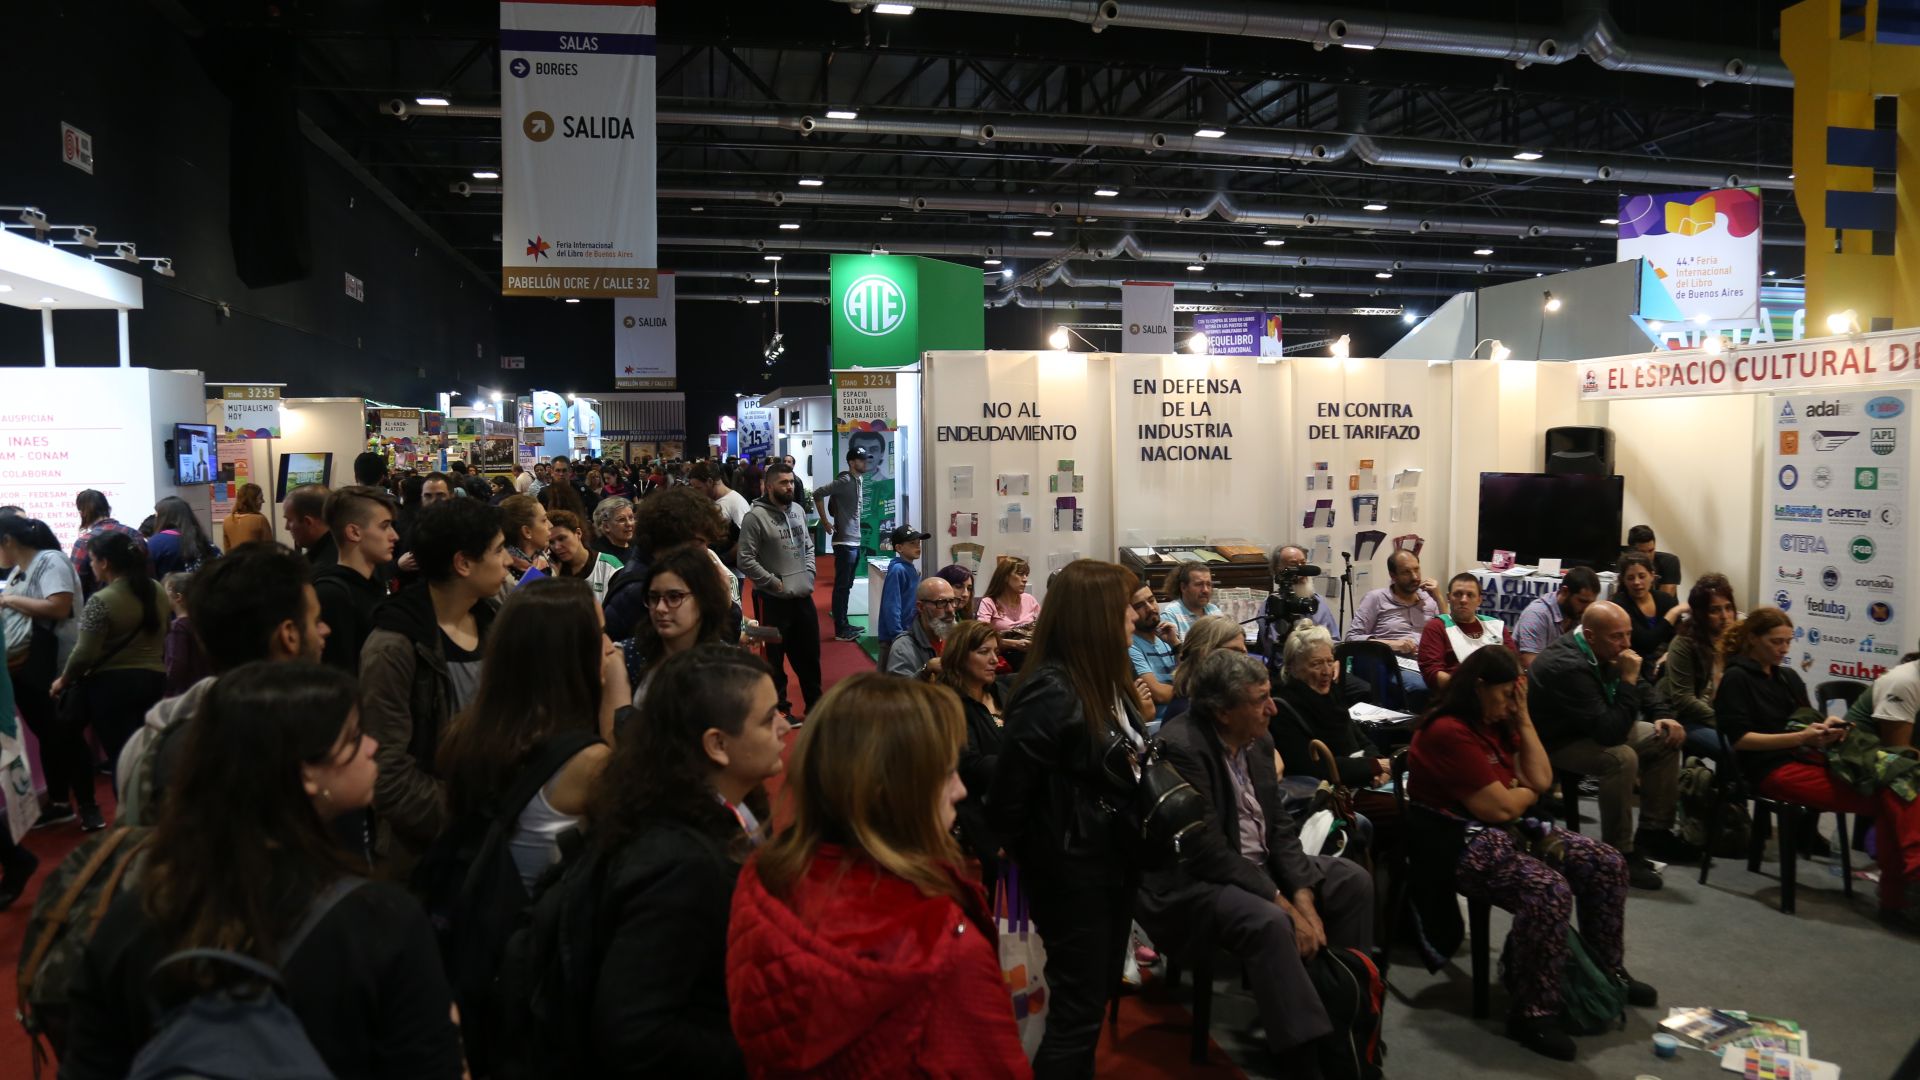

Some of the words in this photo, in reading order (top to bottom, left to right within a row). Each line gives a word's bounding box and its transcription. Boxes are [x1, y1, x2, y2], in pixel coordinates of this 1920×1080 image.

[560, 36, 599, 50] SALAS
[536, 62, 578, 76] BORGES
[563, 116, 634, 139] SALIDA
[573, 241, 614, 249] Internacional
[584, 250, 592, 258] de
[594, 250, 616, 258] Buenos
[618, 250, 634, 258] Aires
[1696, 256, 1718, 265] Feria
[1676, 265, 1732, 277] Internacional
[508, 274, 560, 288] PABELLÓN
[564, 277, 590, 289] OCRE
[593, 277, 600, 290] /
[603, 277, 634, 290] CALLE
[636, 278, 650, 290] 32
[1676, 280, 1688, 288] del
[1691, 279, 1712, 288] Libro
[1676, 290, 1686, 299] de
[1688, 290, 1718, 298] Buenos
[1722, 288, 1744, 296] Aires
[848, 279, 899, 331] ATE
[638, 317, 667, 327] SALIDA
[1142, 324, 1168, 334] SALIDA
[1608, 367, 1628, 390] EL
[1635, 360, 1726, 388] ESPACIO
[1734, 346, 1877, 382] CULTURAL
[863, 375, 891, 386] 3234
[1134, 379, 1156, 394] EN
[1163, 379, 1242, 394] DEFENSA
[248, 388, 274, 398] 3235
[983, 402, 1012, 418] NO
[1018, 402, 1041, 418] AL
[1162, 402, 1185, 417] DE
[1191, 401, 1211, 416] LA
[1318, 403, 1340, 417] EN
[1345, 403, 1413, 418] CONTRA
[1806, 400, 1840, 417] adai
[2, 414, 54, 423] AUSPICIAN
[749, 430, 762, 445] 15
[937, 425, 1077, 441] ENDEUDAMIENTO
[1138, 423, 1233, 440] INDUSTRIA
[1309, 425, 1340, 439] DEL
[1344, 425, 1420, 440] TARIFAZO
[1873, 431, 1895, 439] APL
[8, 436, 49, 446] INAES
[28, 451, 69, 460] CONAM
[1141, 445, 1232, 462] NACIONAL
[2, 470, 62, 478] COLABORAN
[1827, 508, 1871, 518] CePETel
[1780, 534, 1829, 554] CTERA
[1856, 578, 1893, 588] conadu
[1808, 597, 1845, 615] feduba
[1822, 635, 1855, 644] SADOP
